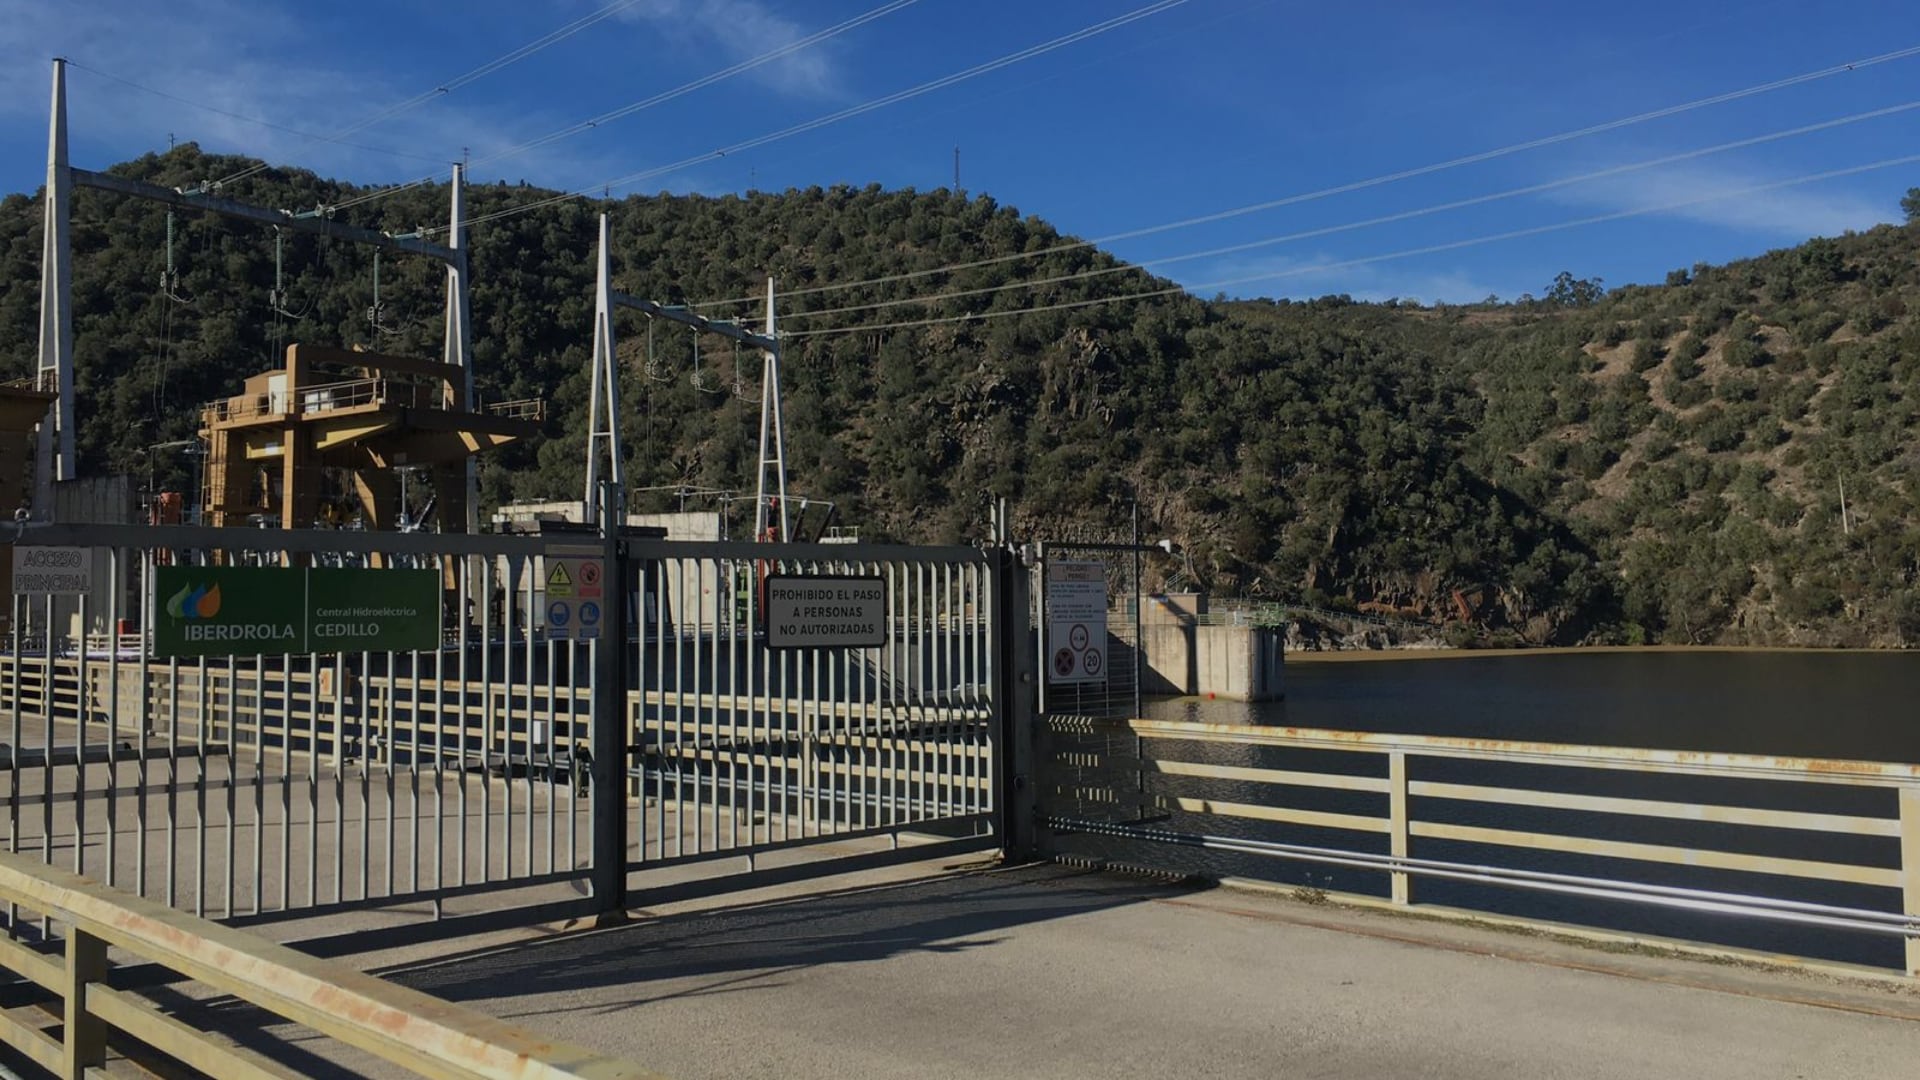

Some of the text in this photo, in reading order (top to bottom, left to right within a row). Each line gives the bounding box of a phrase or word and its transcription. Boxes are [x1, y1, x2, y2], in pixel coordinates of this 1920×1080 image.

[23, 550, 82, 568] ACCESO
[15, 574, 90, 591] PRINCIPAL
[772, 589, 881, 601] PROHIBIDO EL PASO
[316, 607, 351, 617] Central
[792, 606, 863, 618] A PERSONAS
[184, 623, 296, 641] IBERDROLA
[314, 622, 380, 637] CEDILLO
[780, 624, 875, 636] NO AUTORIZADAS
[1086, 655, 1098, 667] 20
